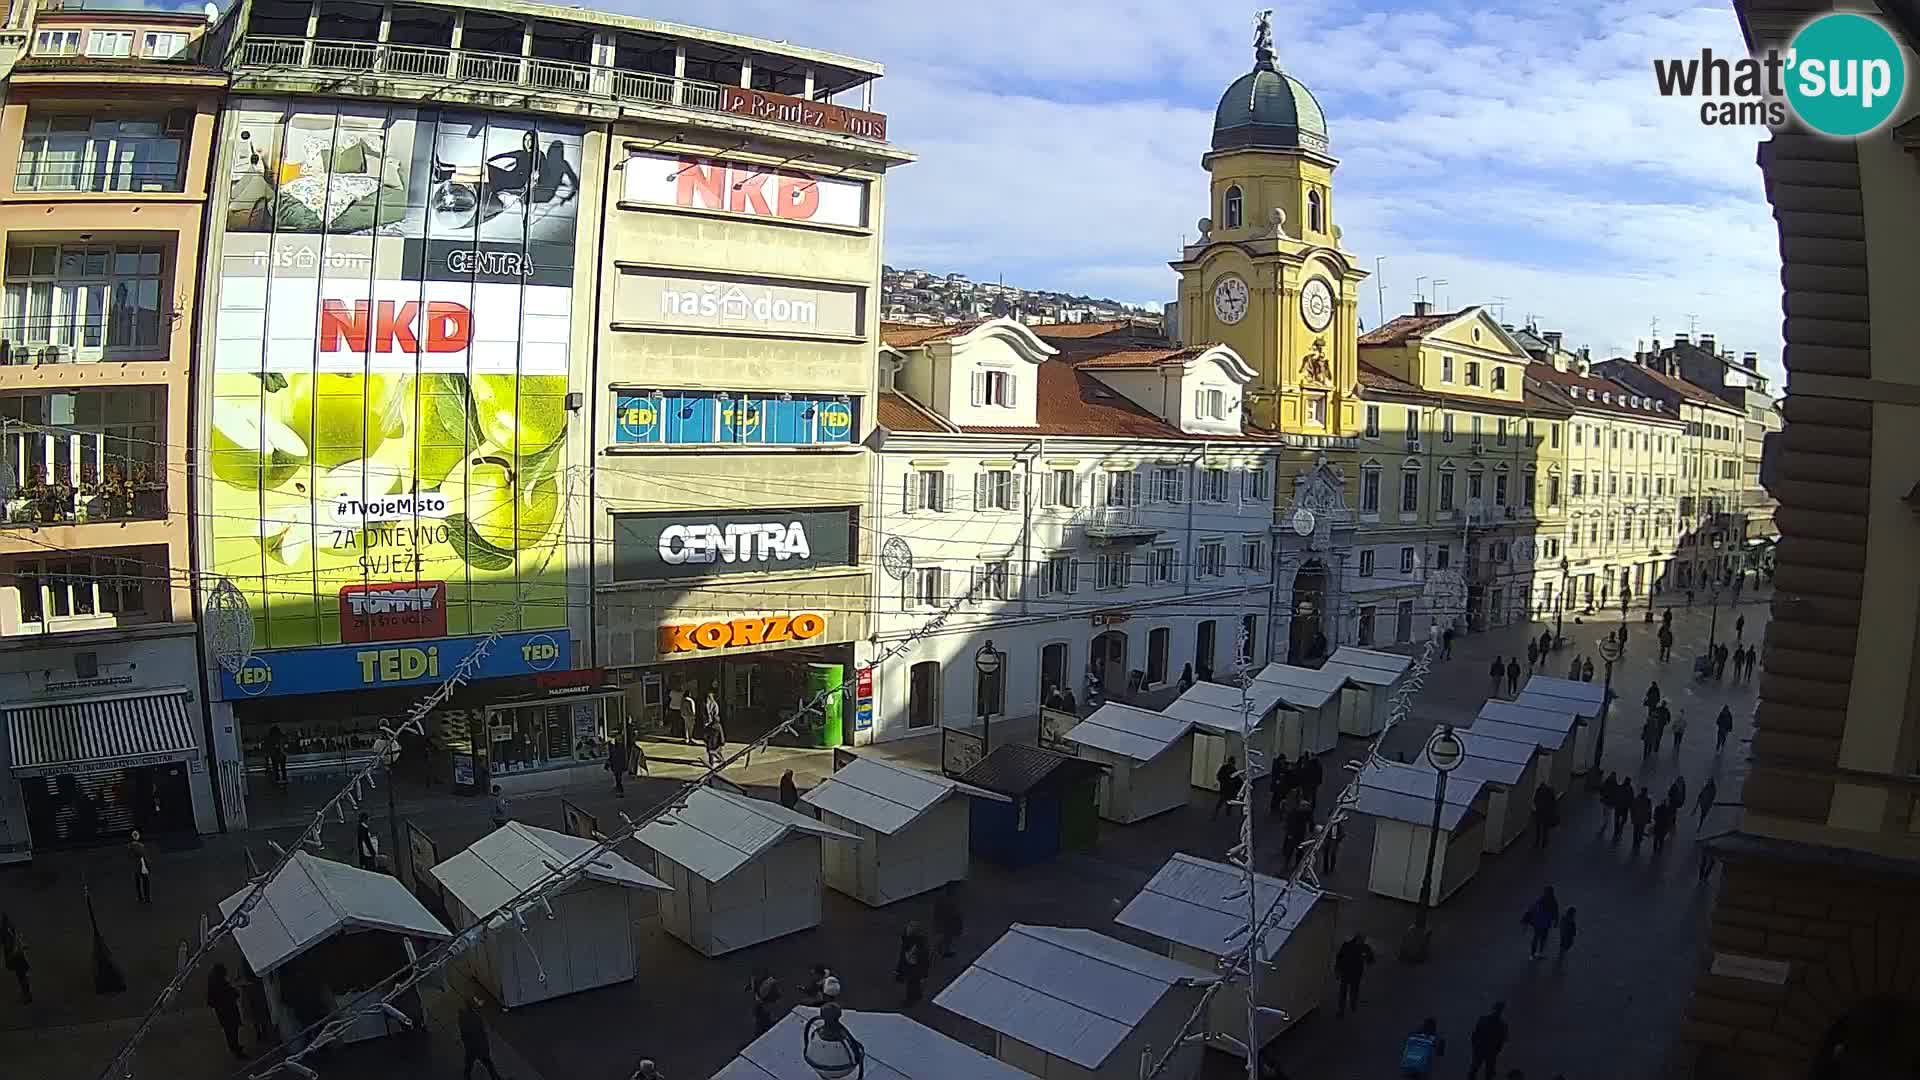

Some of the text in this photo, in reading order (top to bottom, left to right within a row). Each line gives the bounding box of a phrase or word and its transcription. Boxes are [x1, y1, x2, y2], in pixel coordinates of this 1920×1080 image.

[676, 160, 819, 220] NKD
[447, 250, 534, 276] CENTRA
[661, 284, 817, 322] naš dom
[320, 298, 475, 353] NKD
[332, 525, 450, 549] ZA DNEVNO
[658, 520, 811, 566] CENTRA
[358, 547, 425, 576] SVJEŽE
[658, 613, 826, 654] KORZO
[357, 646, 440, 683] TEDi
[522, 643, 560, 662] TEDi
[235, 666, 272, 685] TEDi
